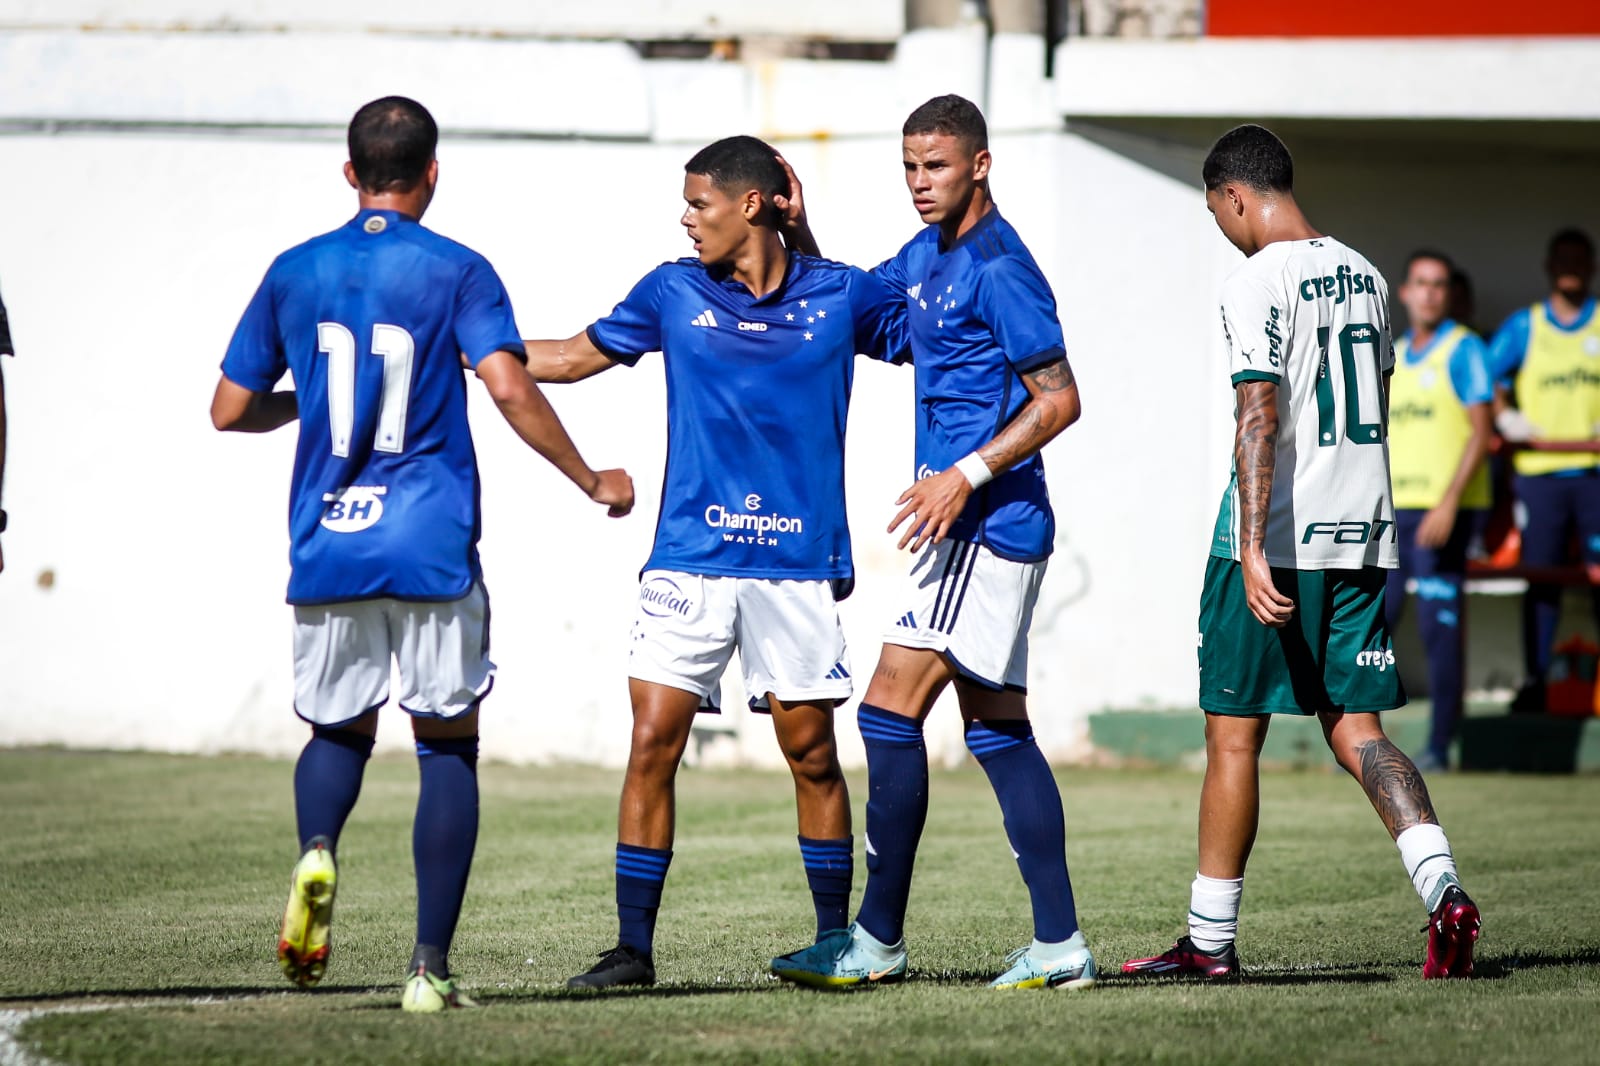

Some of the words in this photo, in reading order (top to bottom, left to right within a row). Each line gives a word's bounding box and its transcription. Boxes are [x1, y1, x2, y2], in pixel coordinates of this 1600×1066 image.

[1301, 265, 1376, 304] crefisa
[1265, 305, 1282, 367] crefia
[317, 322, 414, 458] 11
[1316, 323, 1384, 447] 10
[326, 500, 373, 521] BH
[705, 505, 802, 536] Champion
[722, 534, 778, 546] WATCH
